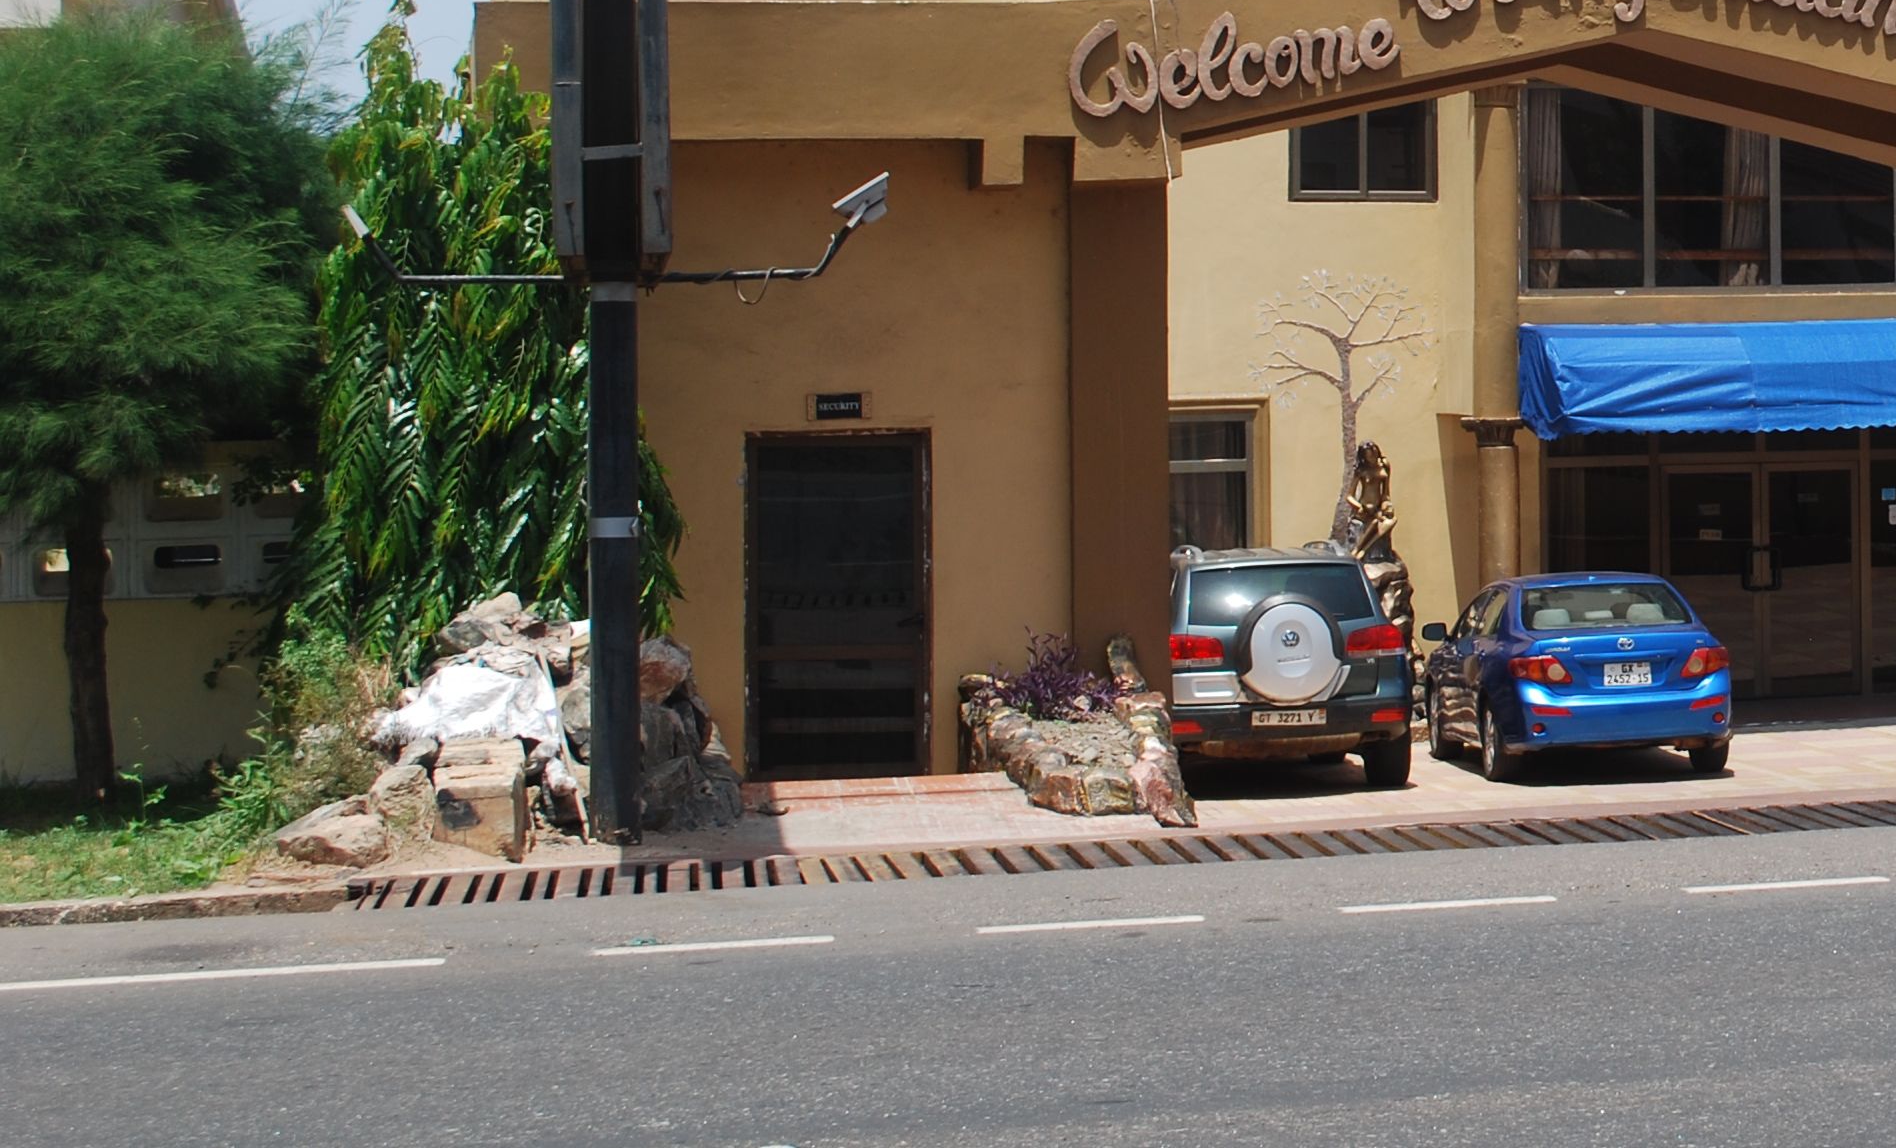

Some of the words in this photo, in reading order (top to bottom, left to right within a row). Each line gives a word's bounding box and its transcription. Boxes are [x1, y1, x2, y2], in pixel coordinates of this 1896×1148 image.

[1069, 11, 1400, 117] Welcome
[818, 401, 860, 412] SECURITY
[1621, 664, 1634, 673] GX
[1258, 713, 1271, 723] GT
[1278, 713, 1303, 723] 3271
